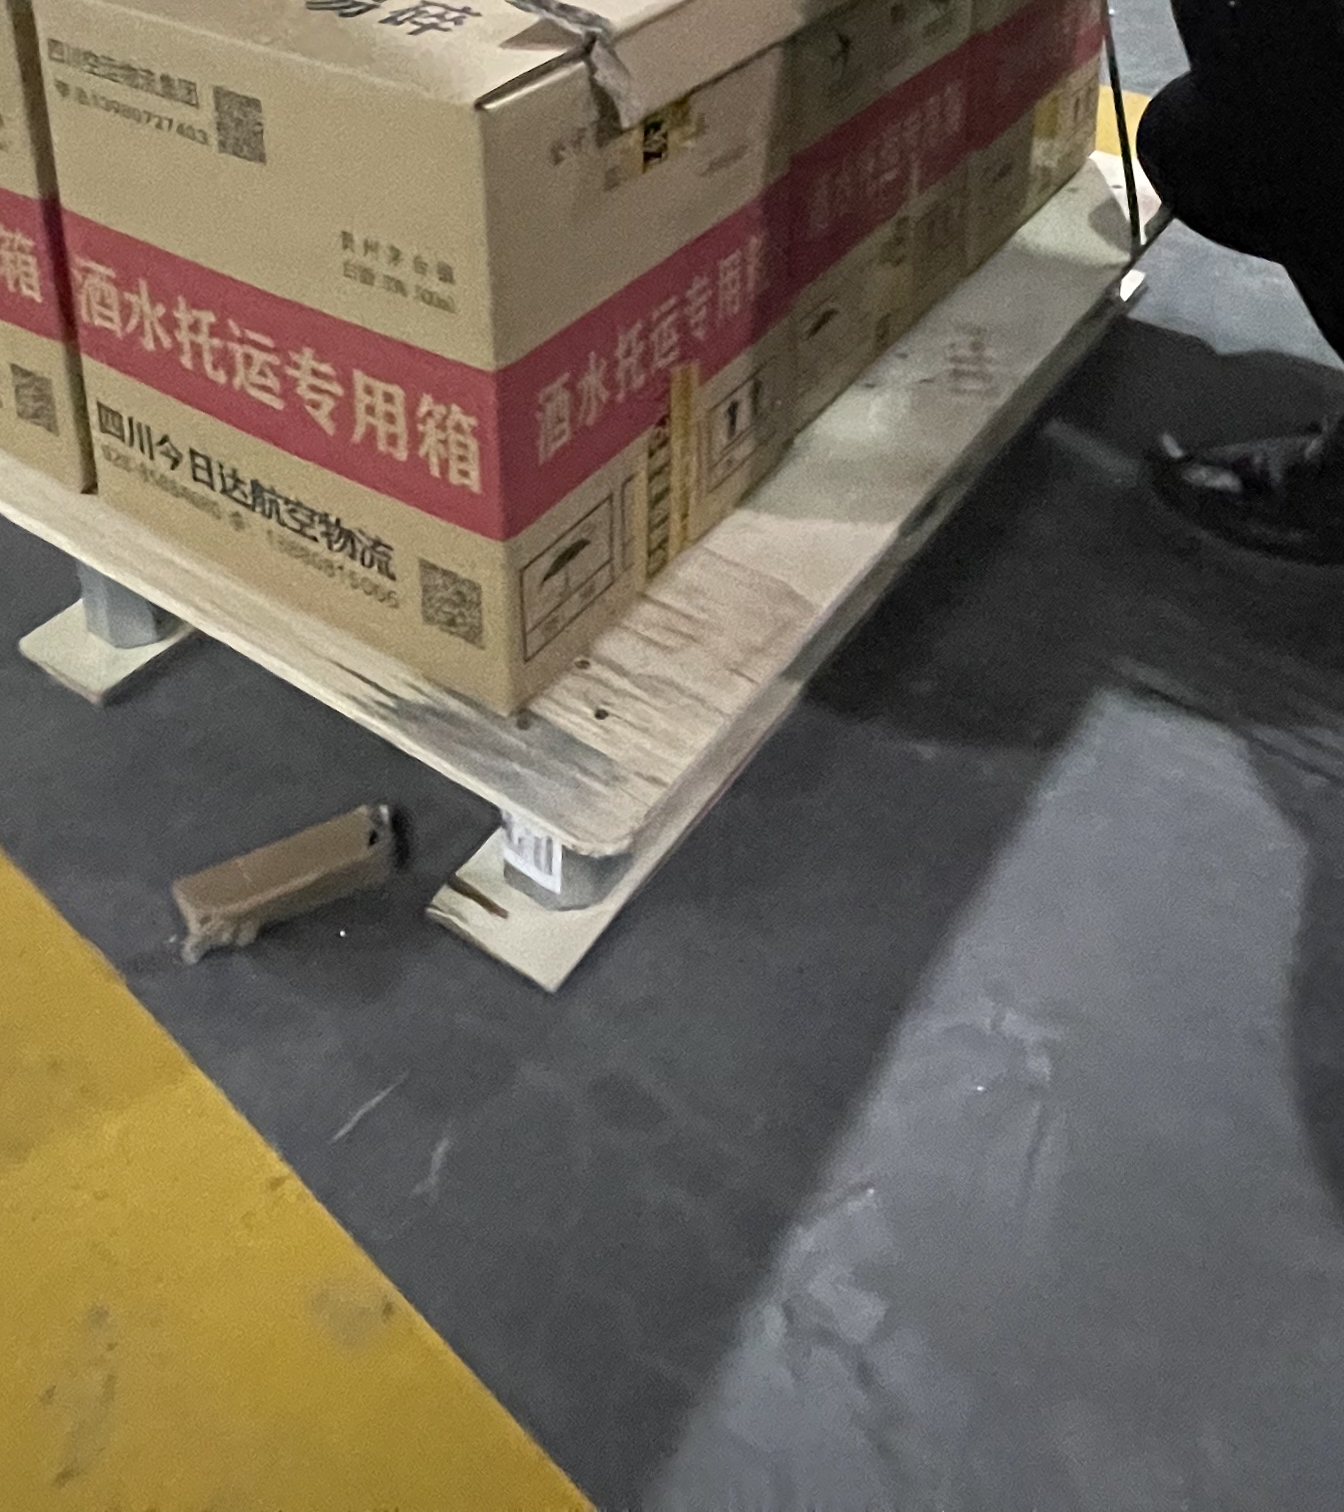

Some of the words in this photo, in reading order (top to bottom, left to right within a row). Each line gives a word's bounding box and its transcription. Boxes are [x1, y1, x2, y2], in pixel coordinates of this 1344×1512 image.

[72, 256, 484, 495] 酒水托运专用箱
[96, 400, 398, 581] 四川今日达航空物流
